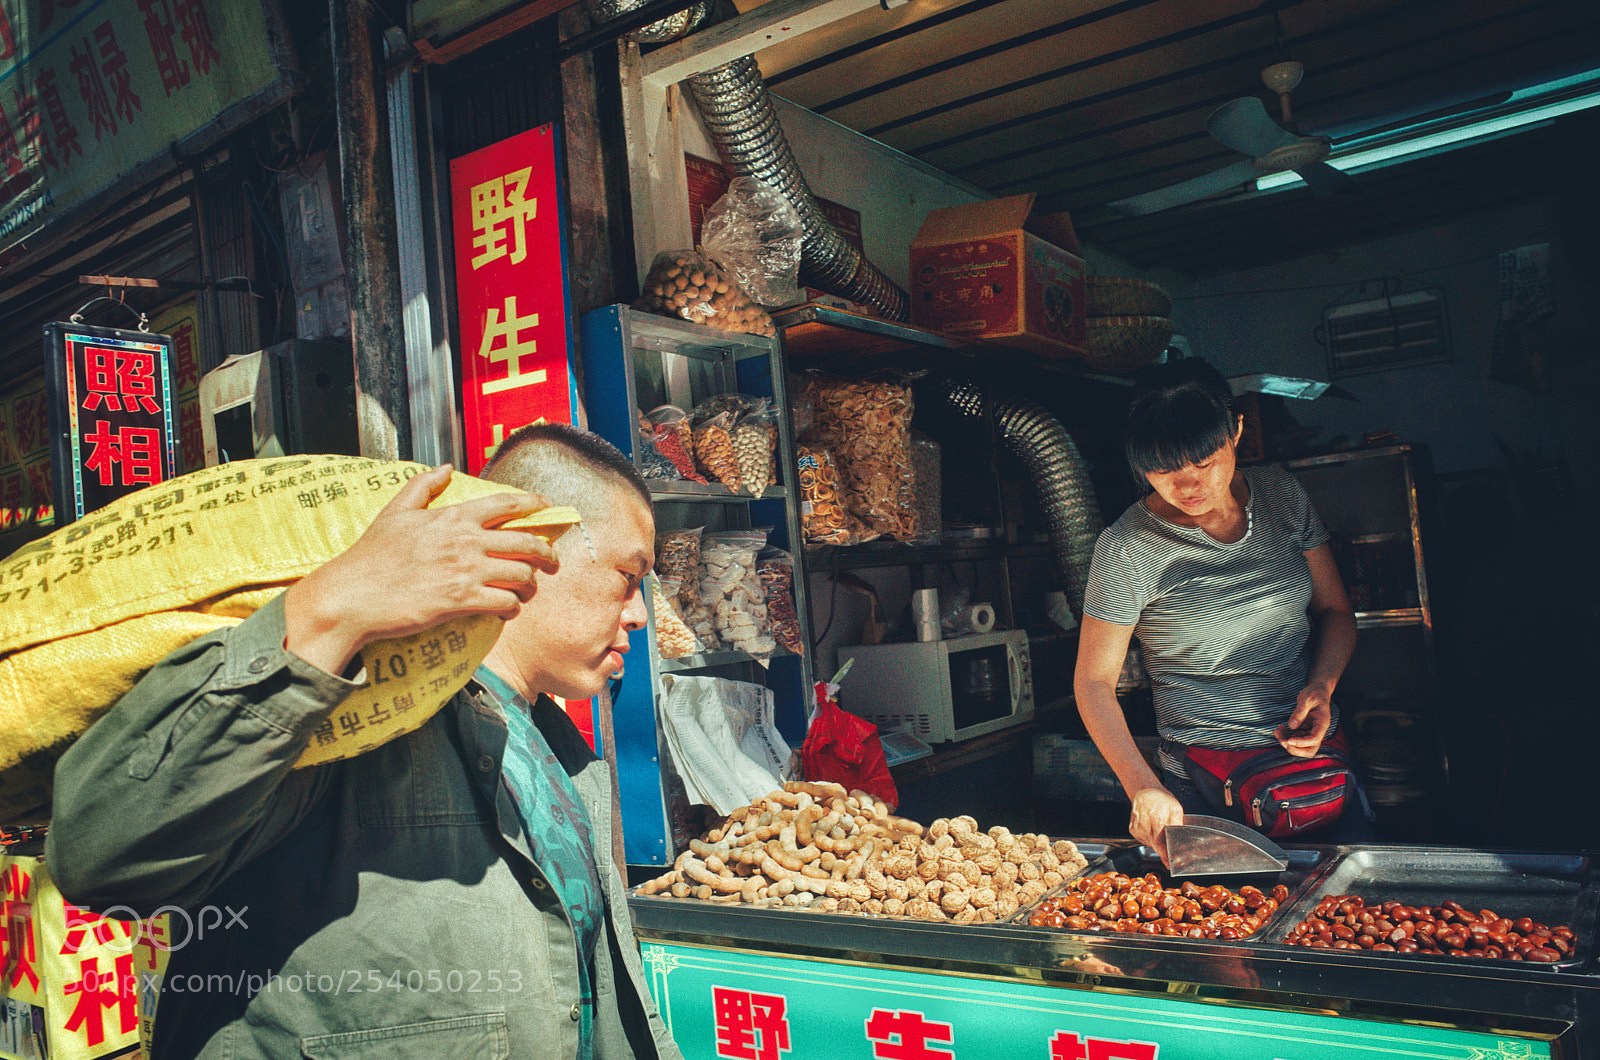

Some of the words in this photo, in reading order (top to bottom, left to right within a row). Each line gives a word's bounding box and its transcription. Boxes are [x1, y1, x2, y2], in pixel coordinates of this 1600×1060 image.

[70, 20, 142, 143] 刻录
[471, 166, 547, 459] 野生
[82, 346, 163, 487] 照相
[305, 660, 470, 749] 地址:南宁市邕
